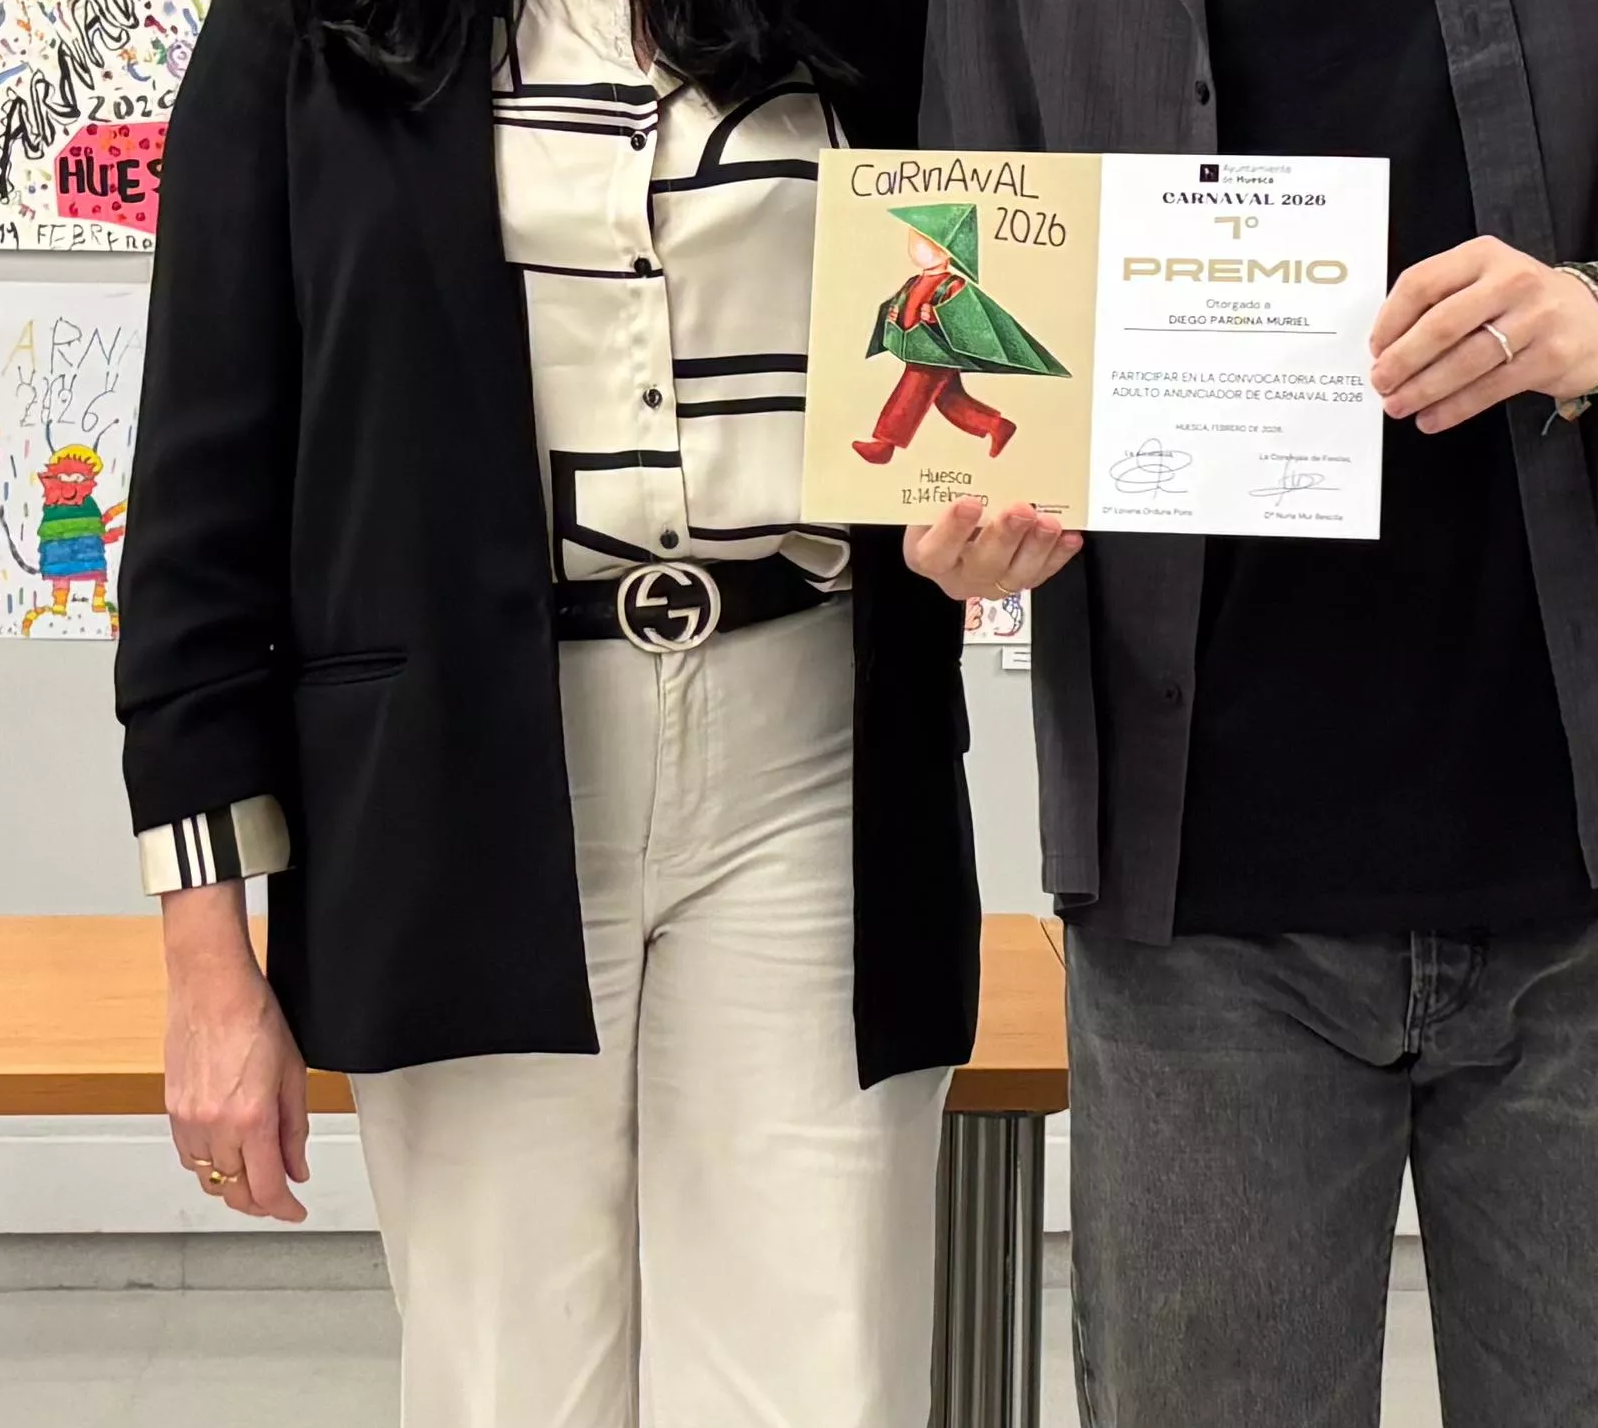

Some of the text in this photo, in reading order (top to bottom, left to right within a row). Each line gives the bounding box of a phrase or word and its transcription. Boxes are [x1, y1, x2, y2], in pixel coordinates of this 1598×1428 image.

[1236, 175, 1274, 185] Huesca
[1162, 191, 1327, 207] CARNAVAL 2026
[994, 206, 1067, 247] 2026
[1123, 257, 1349, 285] PREMIO
[1206, 298, 1272, 311] Otorgado a
[1168, 314, 1207, 325] DIEGO
[1266, 316, 1310, 327] MURIEL
[1111, 370, 1365, 386] PARTICIPAR EN LA CONVOCATORIA CARTEL
[1112, 387, 1363, 403] ADULTO ANUNCIADOR DE CARNAVAL 2026
[919, 468, 973, 485] Huesca
